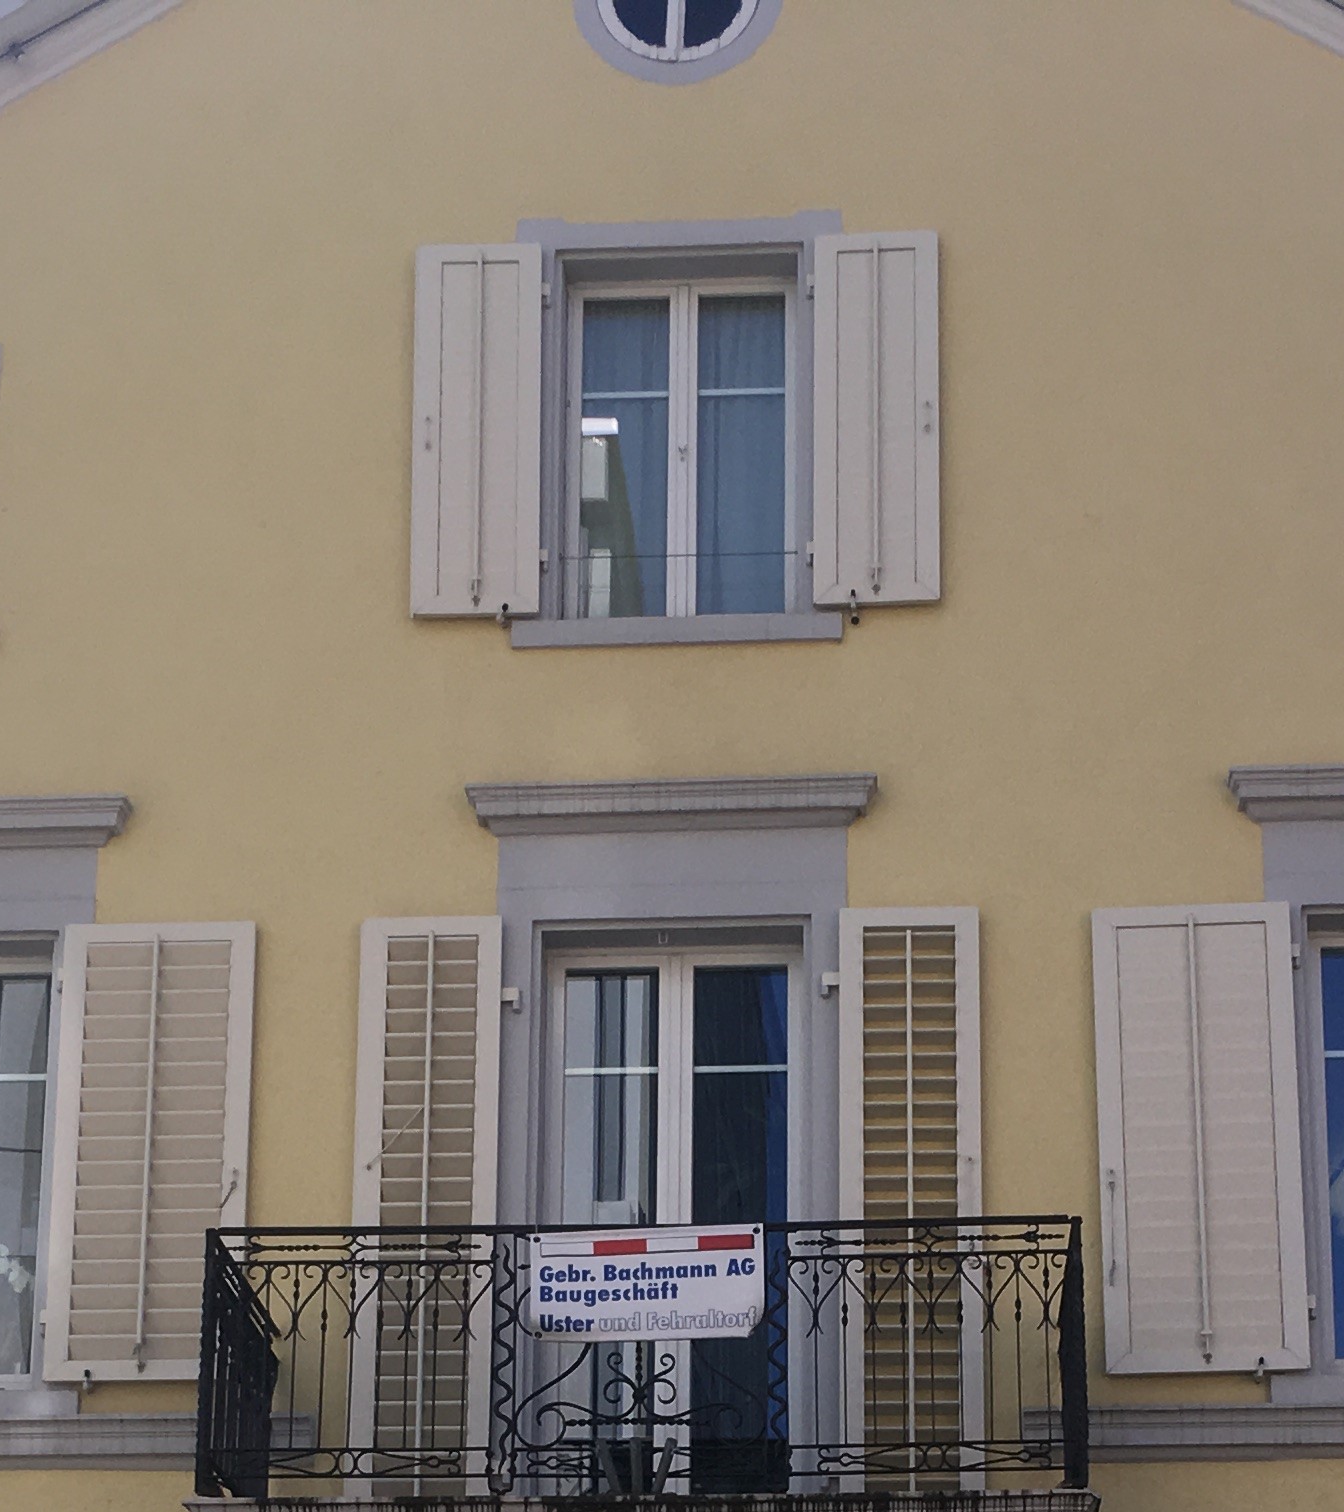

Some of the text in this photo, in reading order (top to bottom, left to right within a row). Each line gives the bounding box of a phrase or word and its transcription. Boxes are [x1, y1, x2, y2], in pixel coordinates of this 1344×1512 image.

[539, 1257, 755, 1283] Gebr. Bachmann AG
[539, 1282, 679, 1307] Baugeschäft
[539, 1306, 758, 1333] Uster und Fehraltorf
